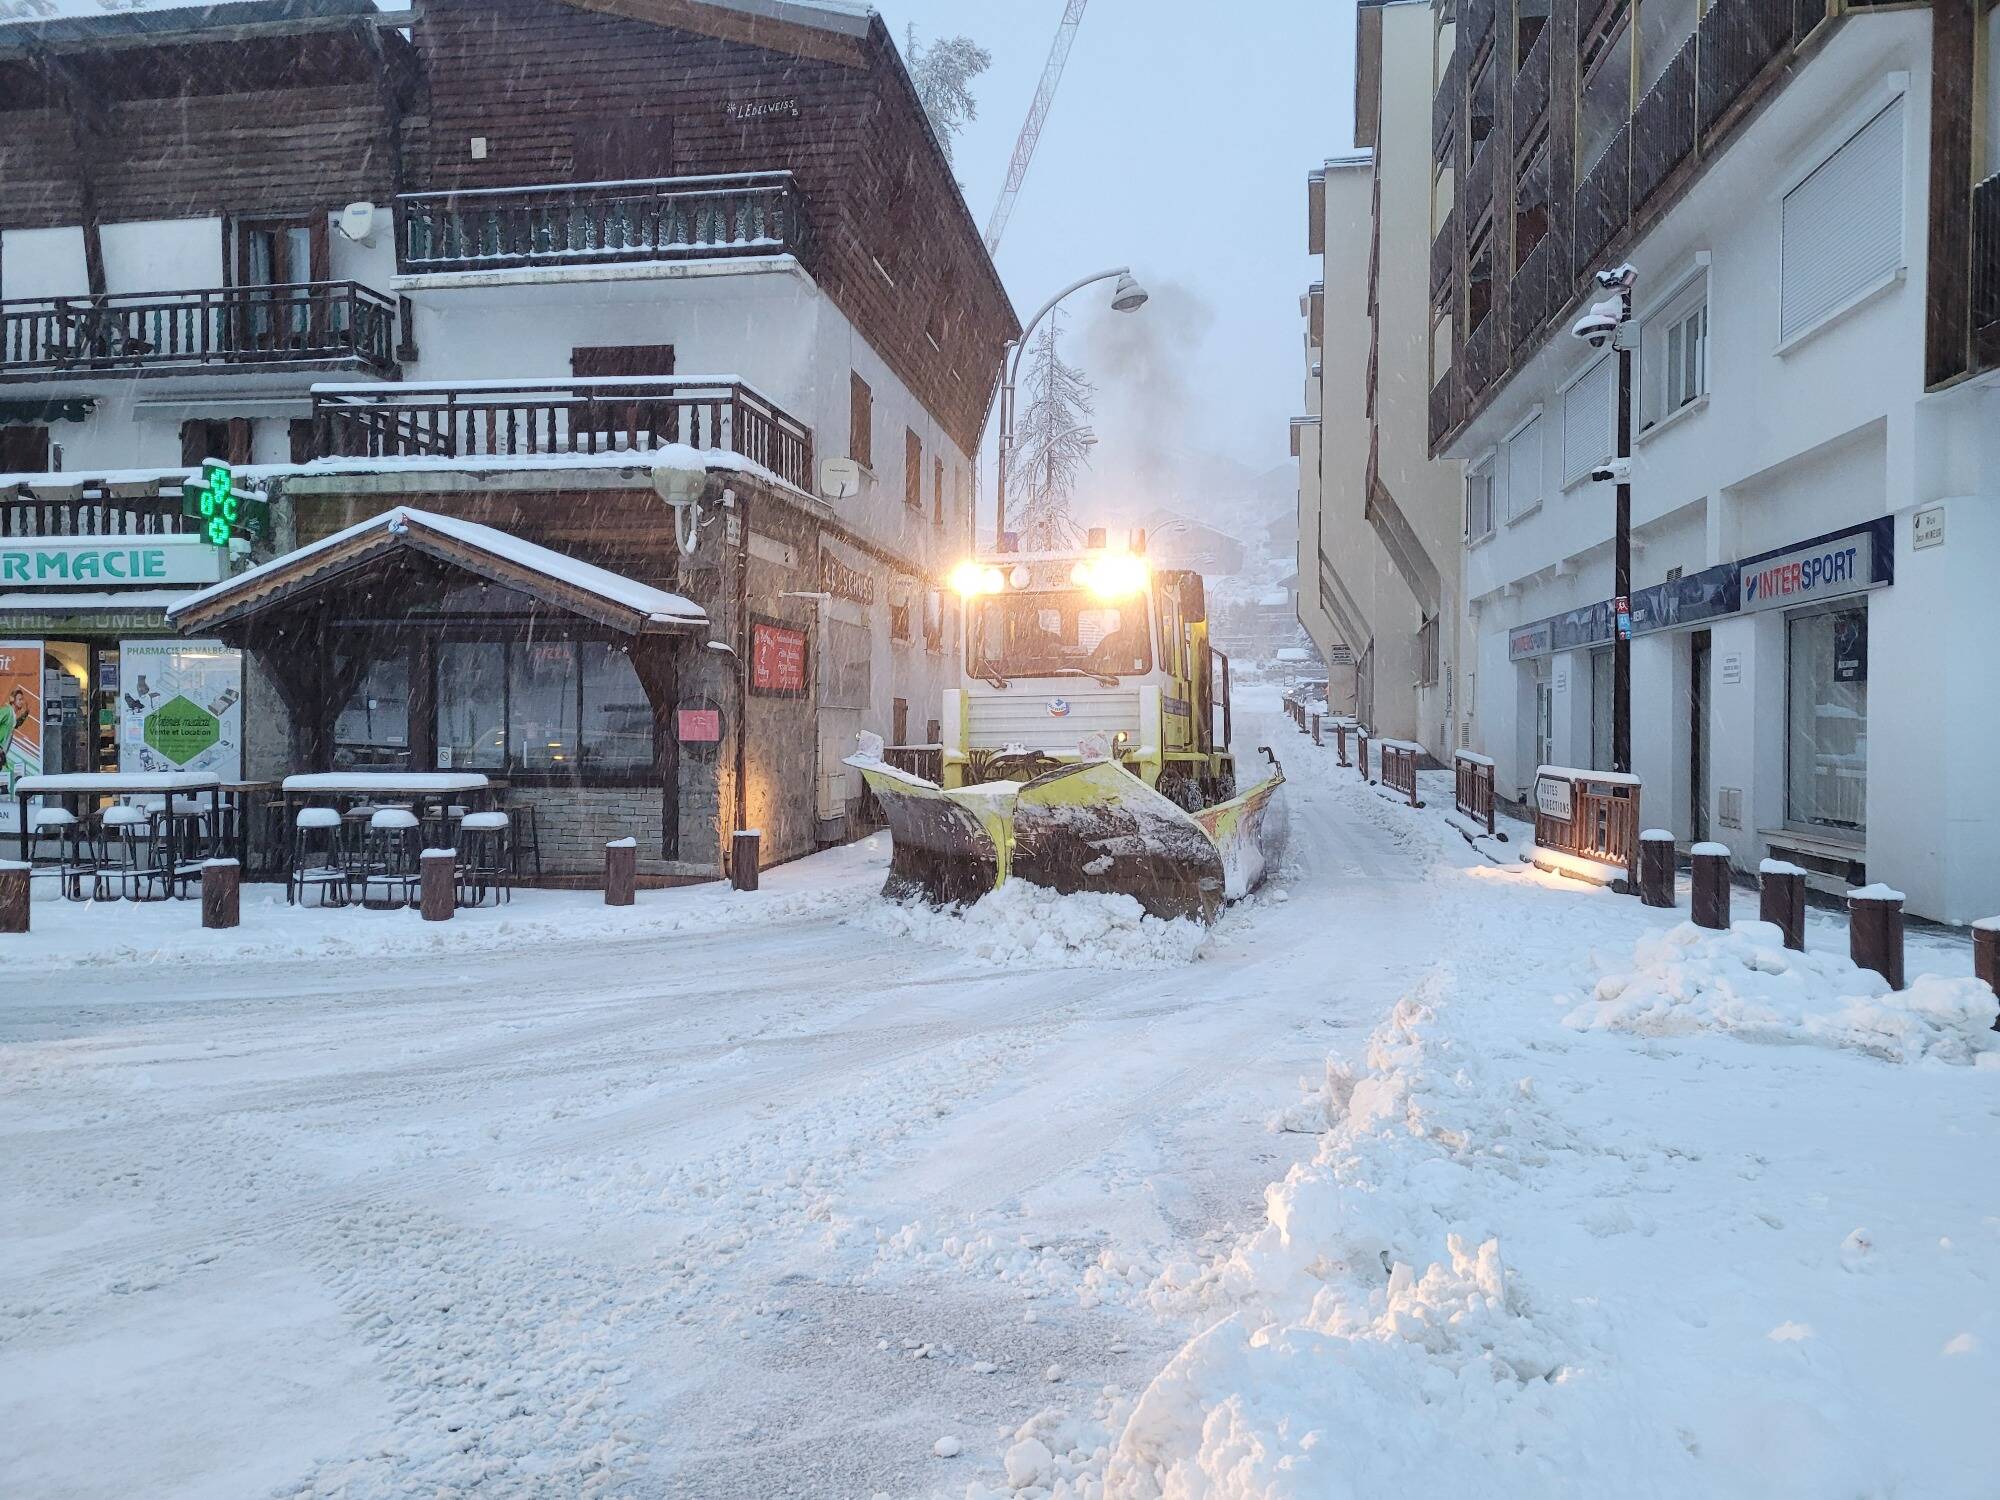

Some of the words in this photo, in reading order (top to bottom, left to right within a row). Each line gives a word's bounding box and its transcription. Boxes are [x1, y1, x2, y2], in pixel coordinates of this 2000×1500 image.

[2, 550, 167, 581] RMACIE
[1758, 547, 1857, 599] INTERSPORT
[127, 646, 180, 655] PHARMACIE
[172, 728, 179, 736] et
[180, 728, 211, 736] Location
[1540, 783, 1558, 796] TOUTES
[1541, 797, 1570, 815] DIRECTIONS
